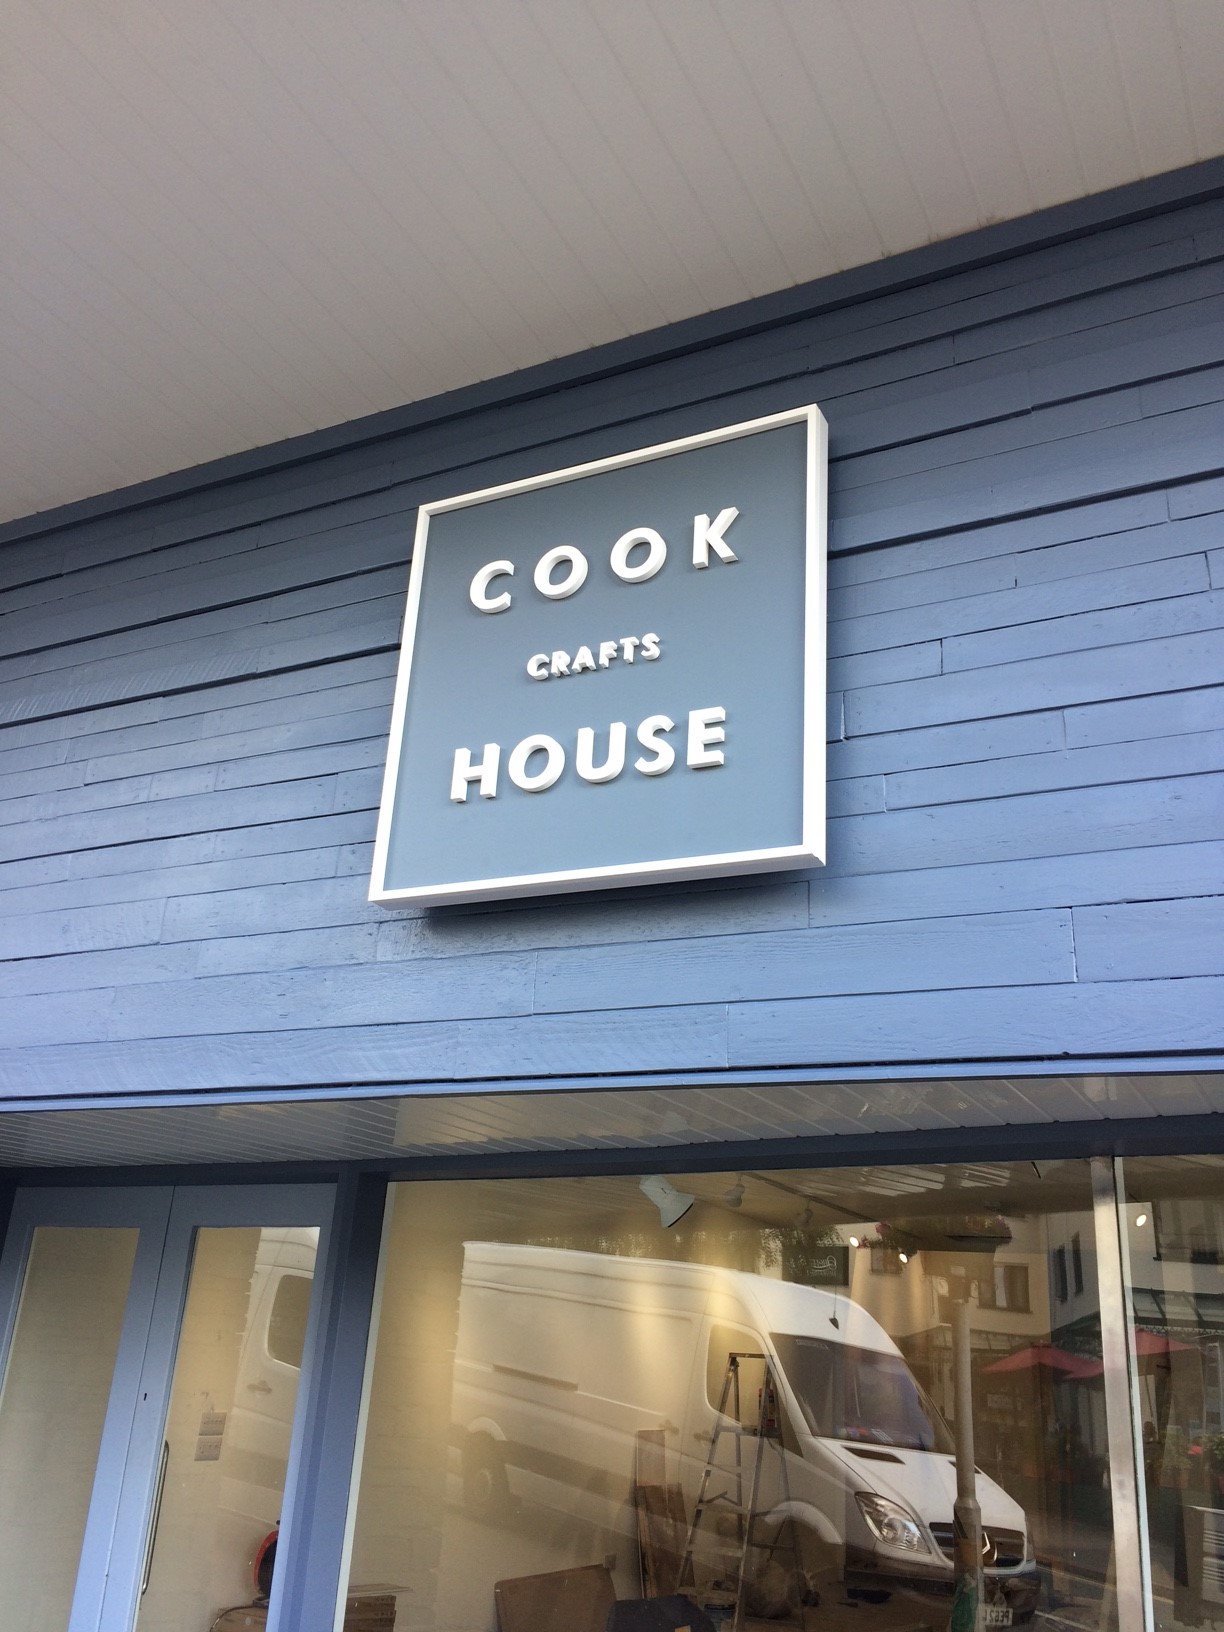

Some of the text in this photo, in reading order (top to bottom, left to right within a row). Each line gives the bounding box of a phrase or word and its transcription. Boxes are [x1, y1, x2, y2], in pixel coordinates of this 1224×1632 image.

[469, 506, 740, 614] COOK
[526, 632, 662, 681] CRAFTS
[450, 706, 727, 803] HOUSE
